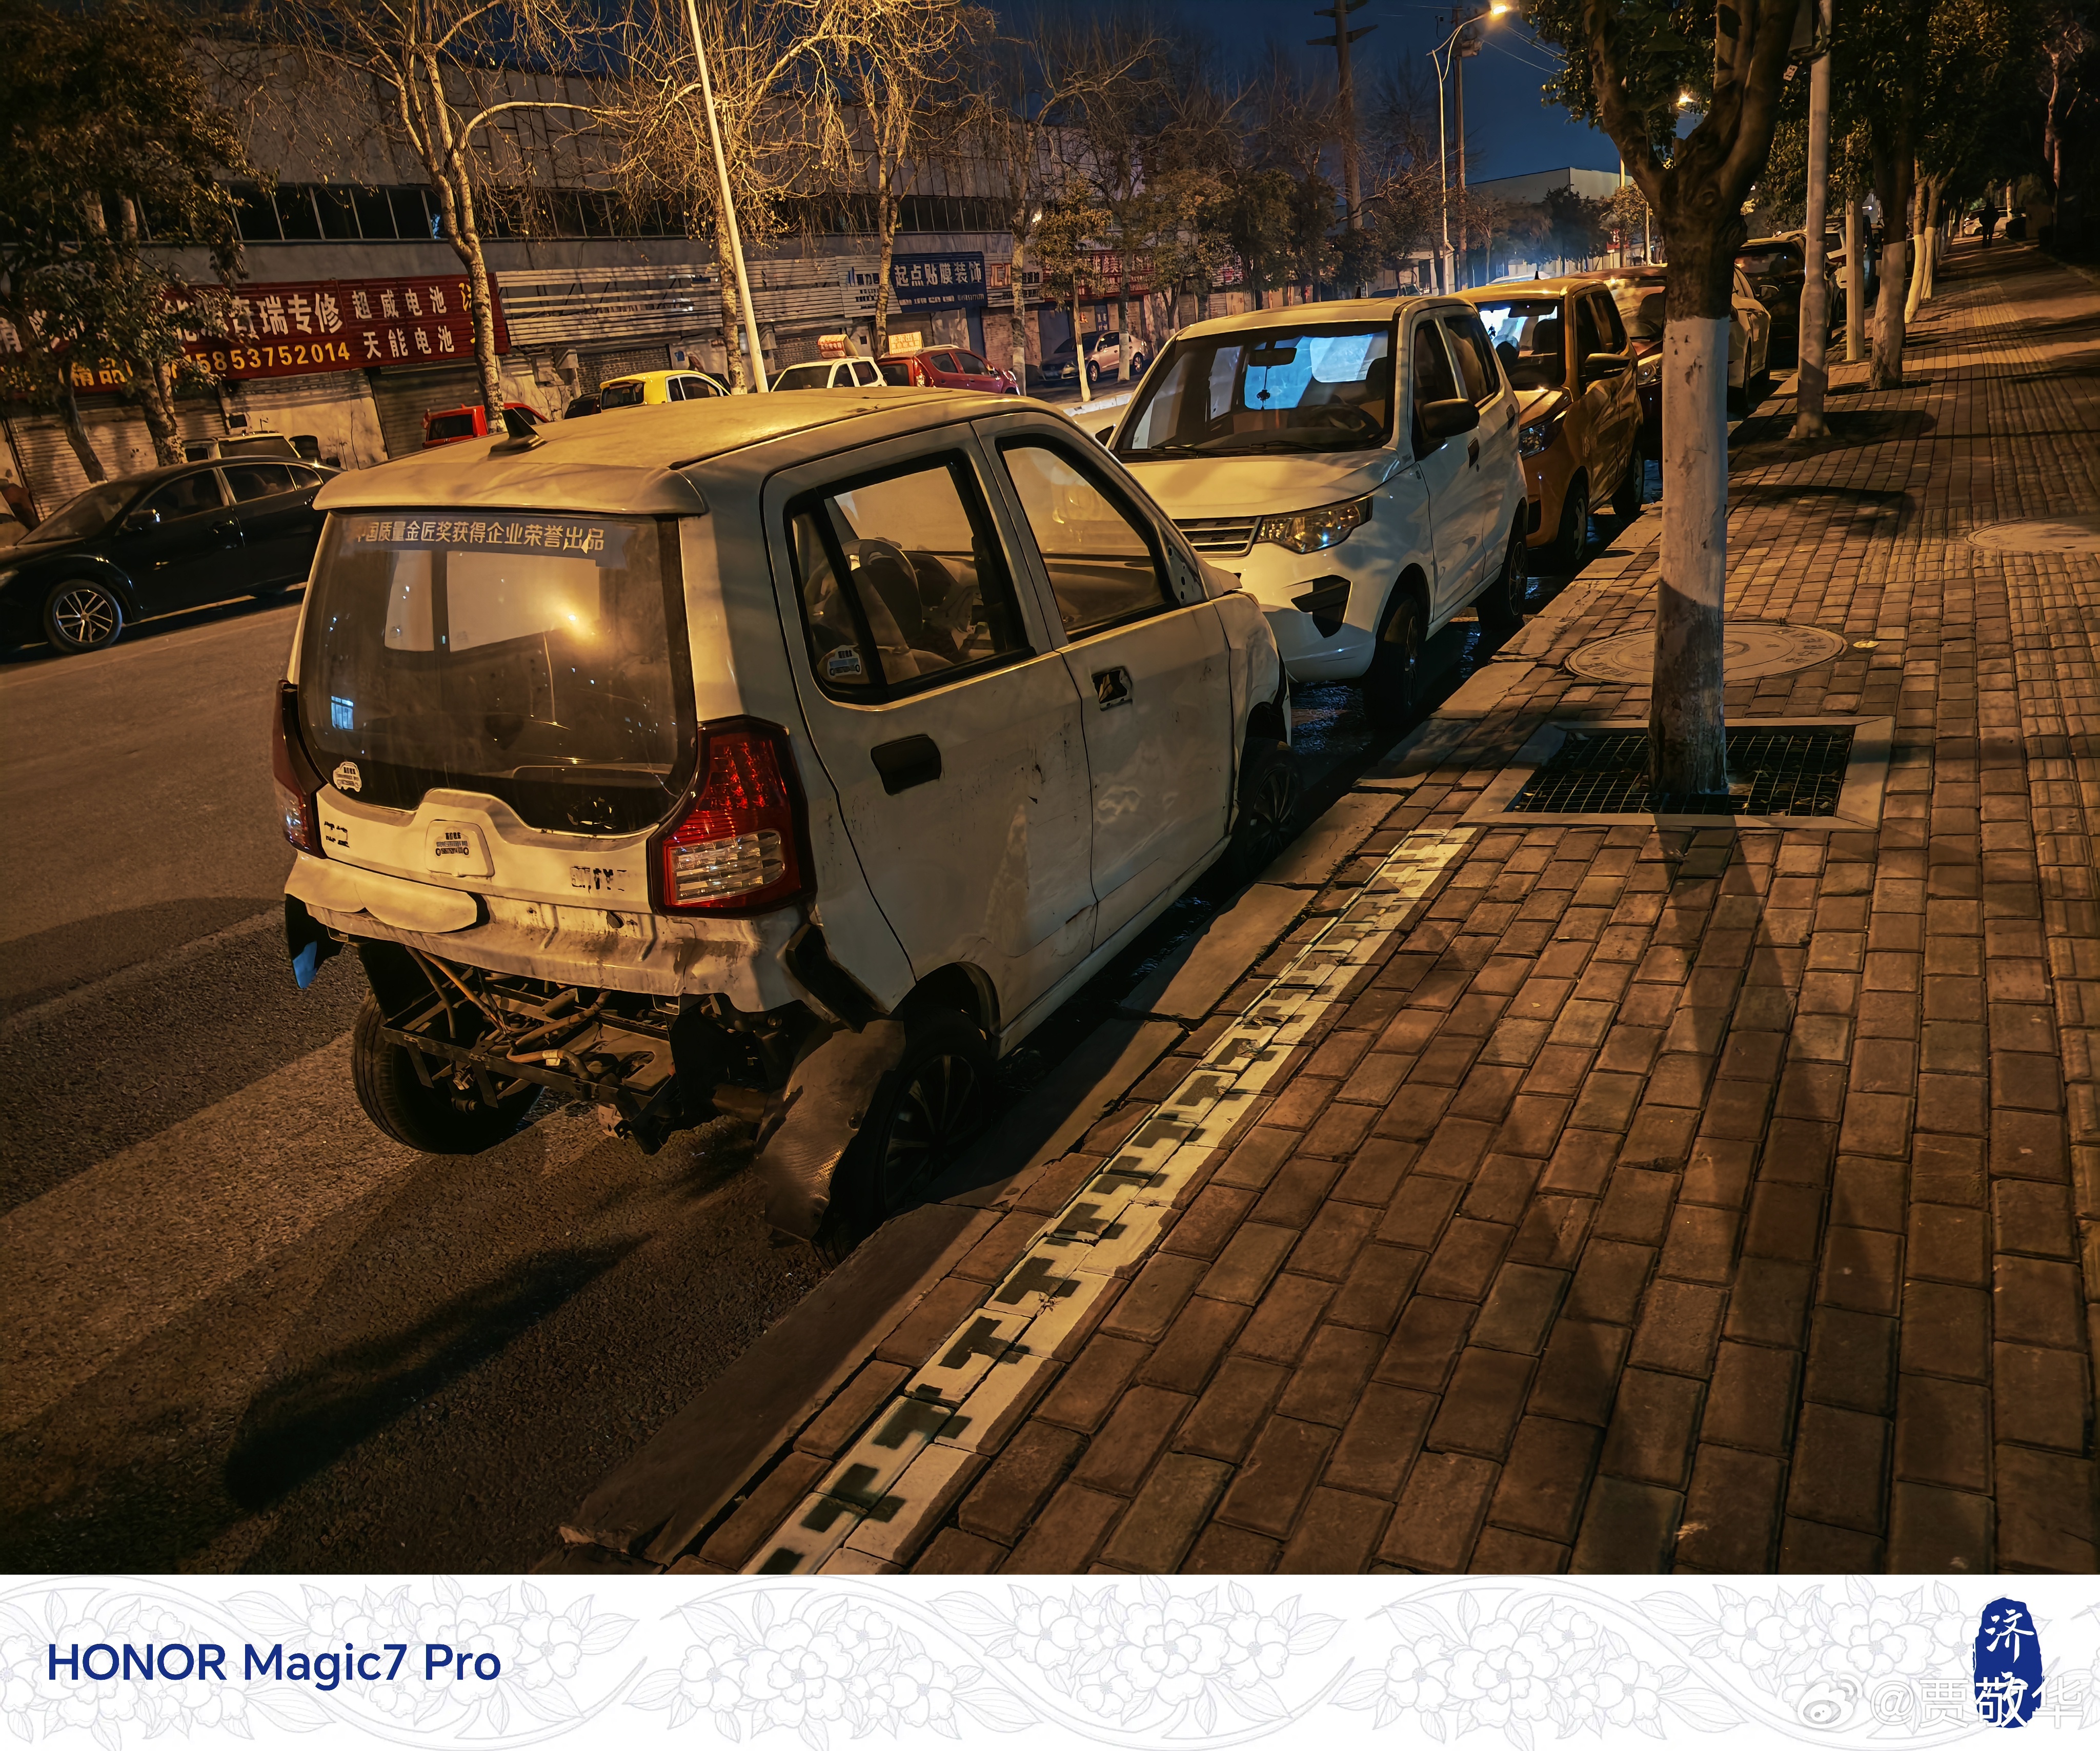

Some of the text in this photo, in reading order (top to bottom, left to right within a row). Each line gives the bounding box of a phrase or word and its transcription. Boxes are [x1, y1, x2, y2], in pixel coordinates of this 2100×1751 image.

[894, 261, 982, 288] 起点贴膜装饰
[351, 286, 447, 319] 超威电池
[362, 325, 455, 360] 天能电池
[356, 520, 604, 551] 国质量金匠奖获得企业荣誉出品
